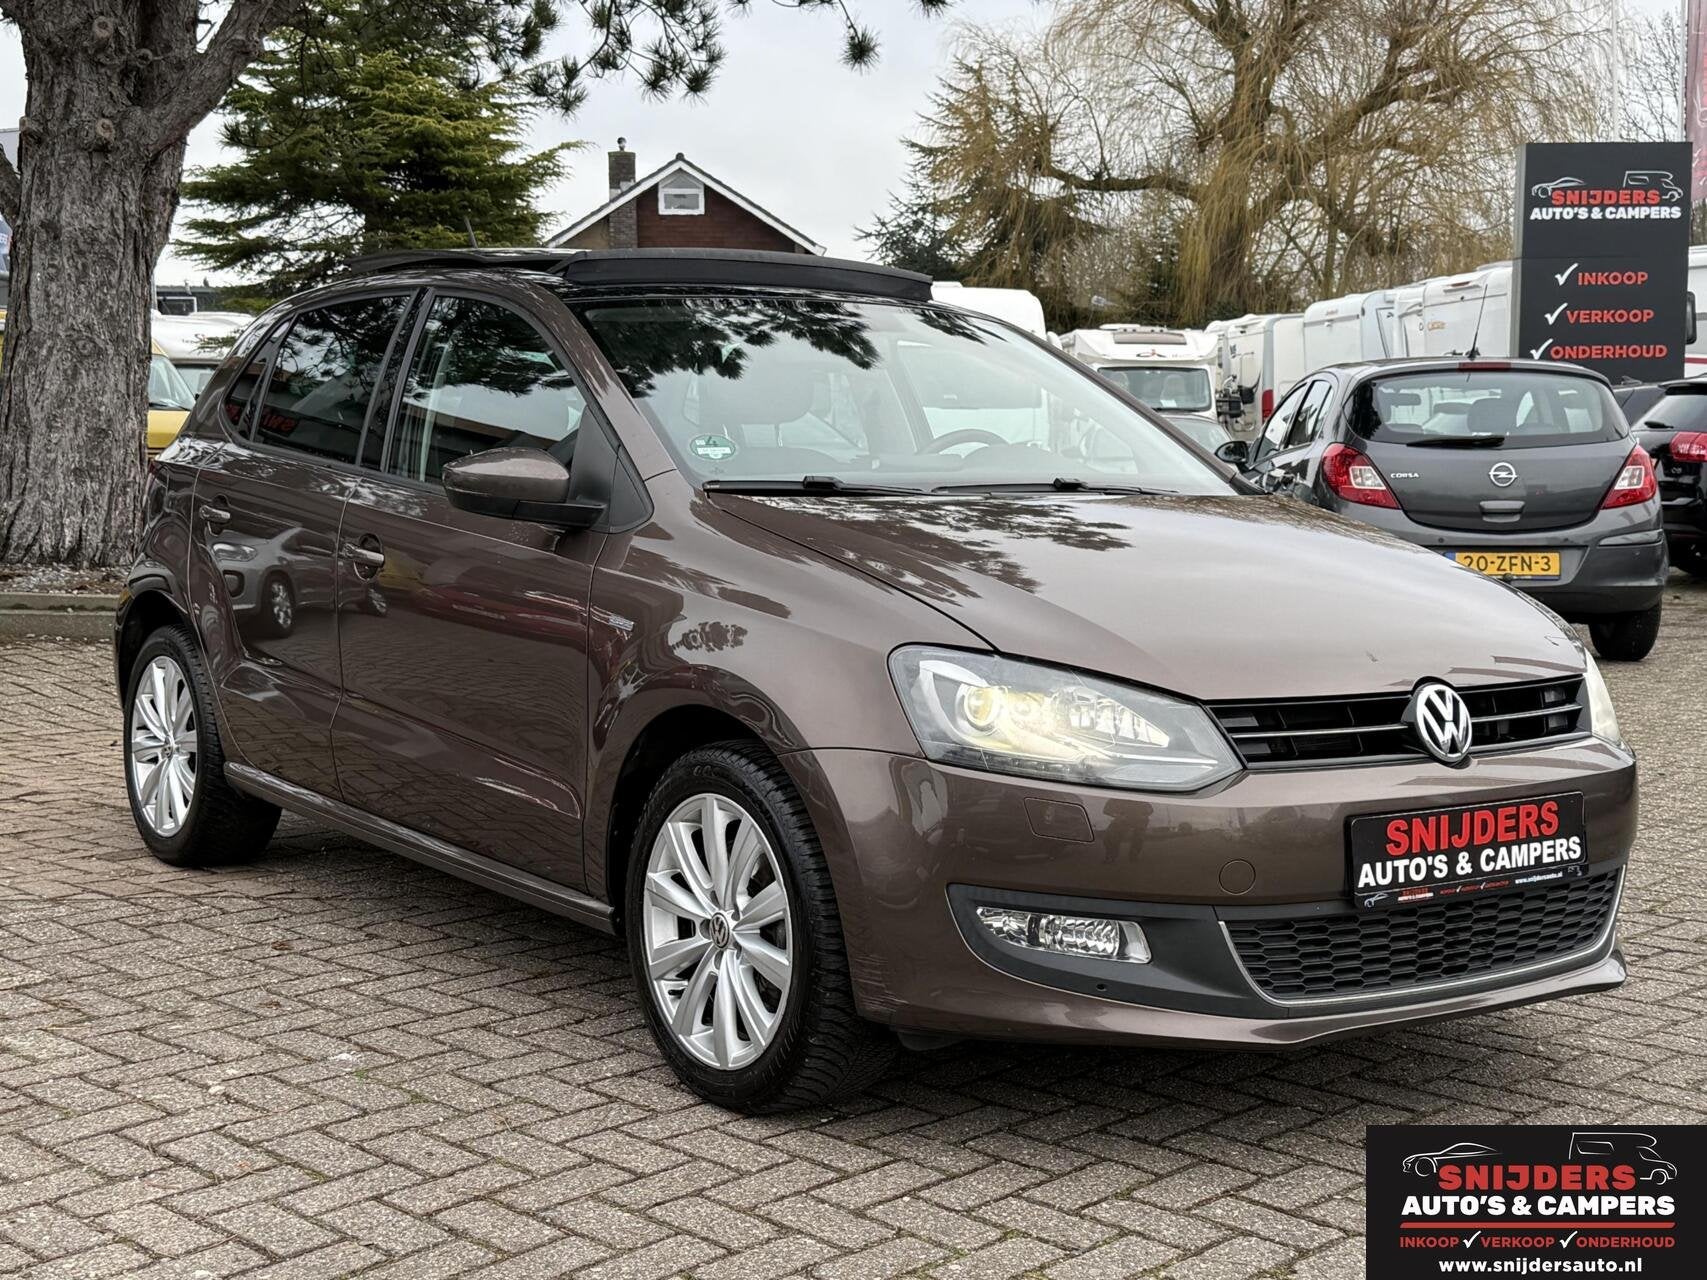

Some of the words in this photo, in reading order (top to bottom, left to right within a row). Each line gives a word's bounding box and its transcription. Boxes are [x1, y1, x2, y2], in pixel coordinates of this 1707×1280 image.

[1551, 189, 1661, 206] SNIJDERS
[1529, 207, 1589, 220] AUTO'S
[1591, 207, 1603, 219] &
[1605, 206, 1682, 219] CAMPERS
[1577, 271, 1648, 286] INKOOP
[1566, 309, 1655, 324] VERKOOP
[1550, 345, 1668, 359] ONDERHOUD
[1463, 555, 1551, 572] 20-ZFN-3
[1386, 800, 1560, 856] SNIJDERS
[1357, 854, 1449, 888] AUTO'S
[1455, 851, 1473, 876] &
[1480, 836, 1582, 872] CAMPERS
